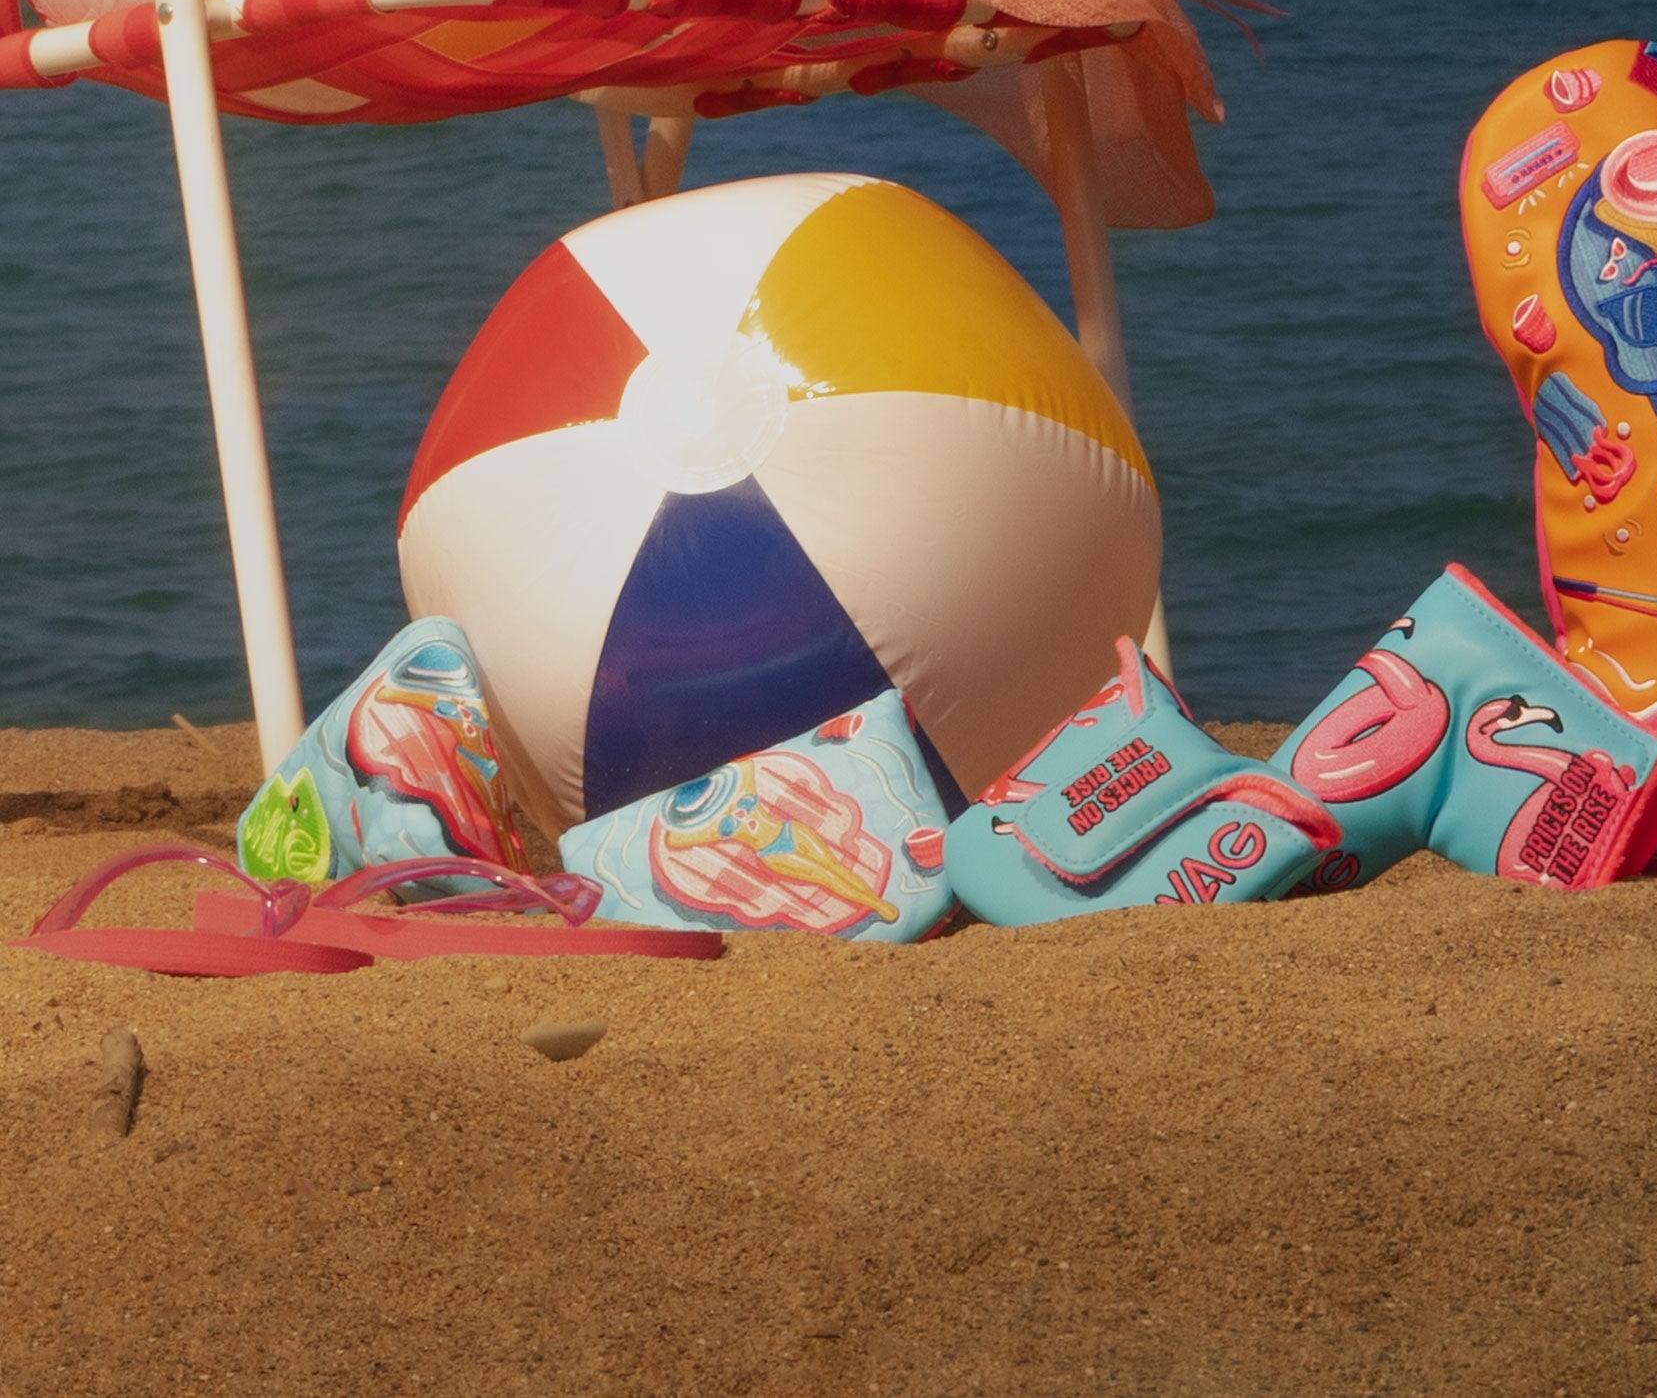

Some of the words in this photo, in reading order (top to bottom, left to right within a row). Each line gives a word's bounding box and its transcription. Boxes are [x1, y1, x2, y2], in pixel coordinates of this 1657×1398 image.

[1097, 751, 1172, 812] PRICES
[1105, 737, 1154, 773] THE
[1061, 763, 1113, 808] RISE
[1067, 800, 1104, 836] ON
[1519, 787, 1577, 873] PRICES
[1560, 753, 1597, 795] ON
[1546, 833, 1590, 885] THE
[1571, 784, 1618, 844] RISE
